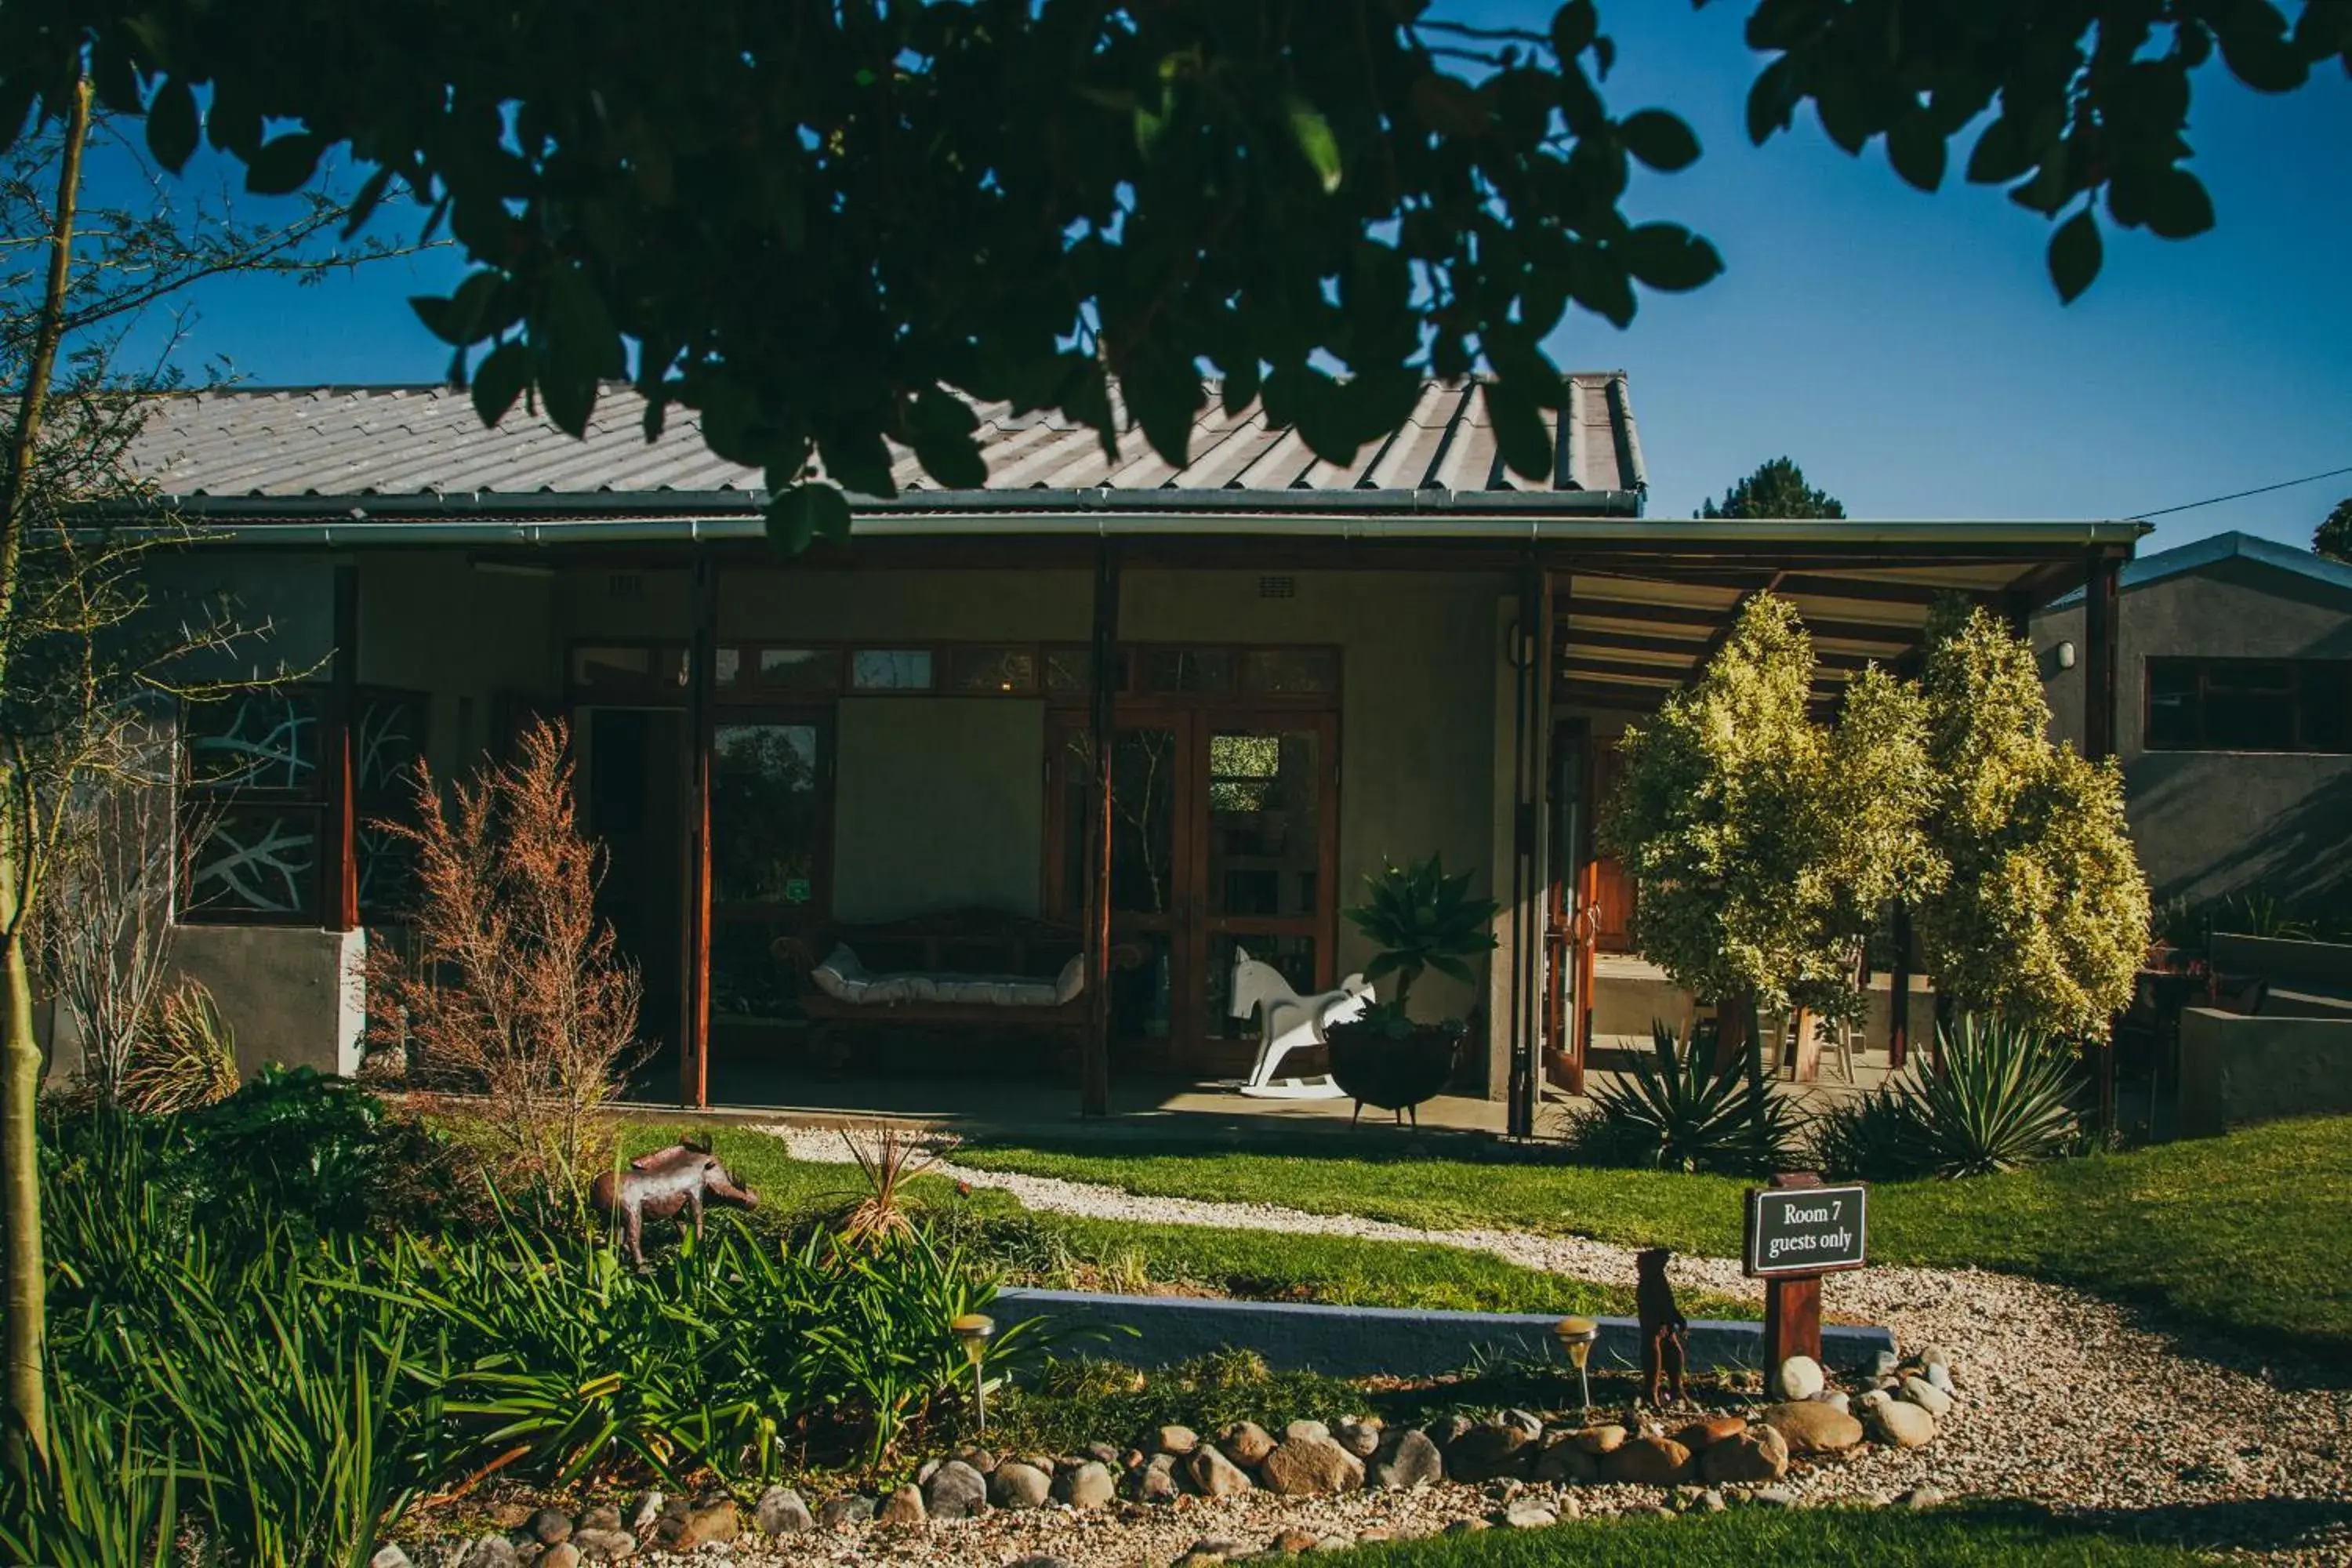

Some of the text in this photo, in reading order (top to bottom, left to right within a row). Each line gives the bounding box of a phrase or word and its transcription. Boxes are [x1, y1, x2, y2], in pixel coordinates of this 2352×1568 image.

[1784, 1200, 1842, 1225] Room 7
[1769, 1226, 1852, 1258] guests only
